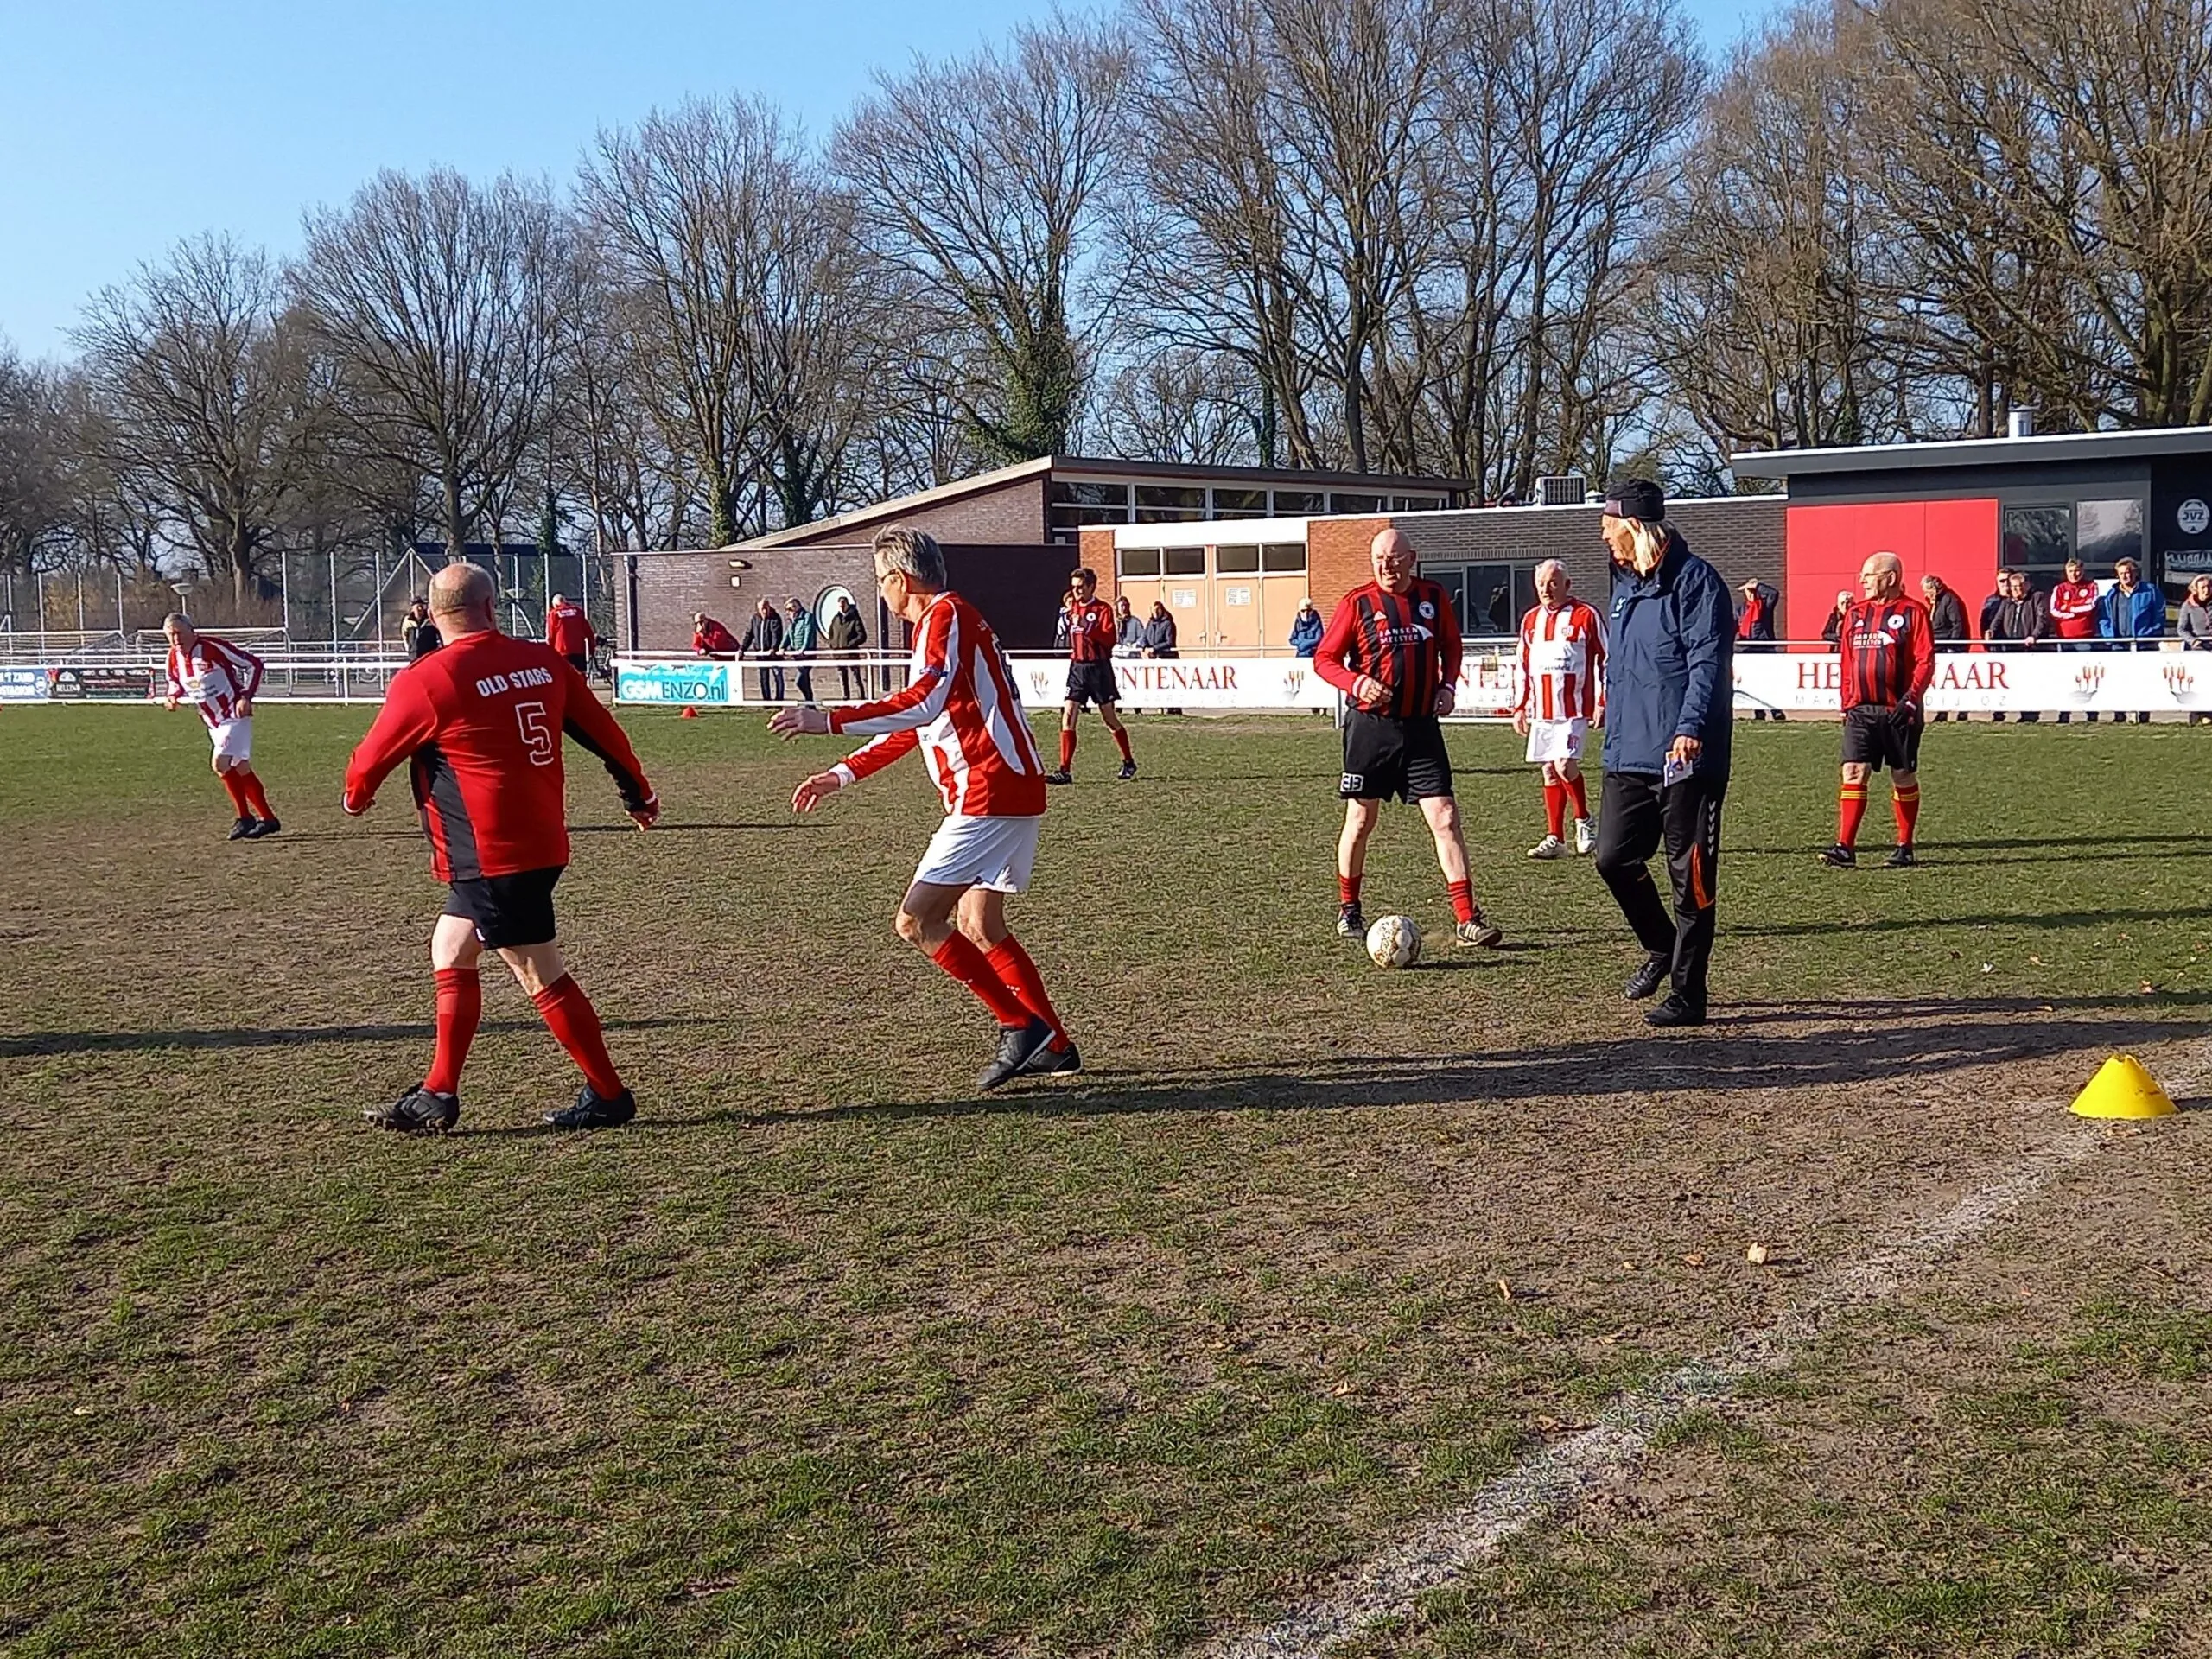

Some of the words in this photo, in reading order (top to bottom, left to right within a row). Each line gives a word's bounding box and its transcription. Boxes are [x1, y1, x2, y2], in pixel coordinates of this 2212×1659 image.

[476, 674, 509, 697] OLD
[509, 666, 554, 689] STARS
[1115, 665, 1238, 690] NTENAAR
[515, 702, 555, 766] 5
